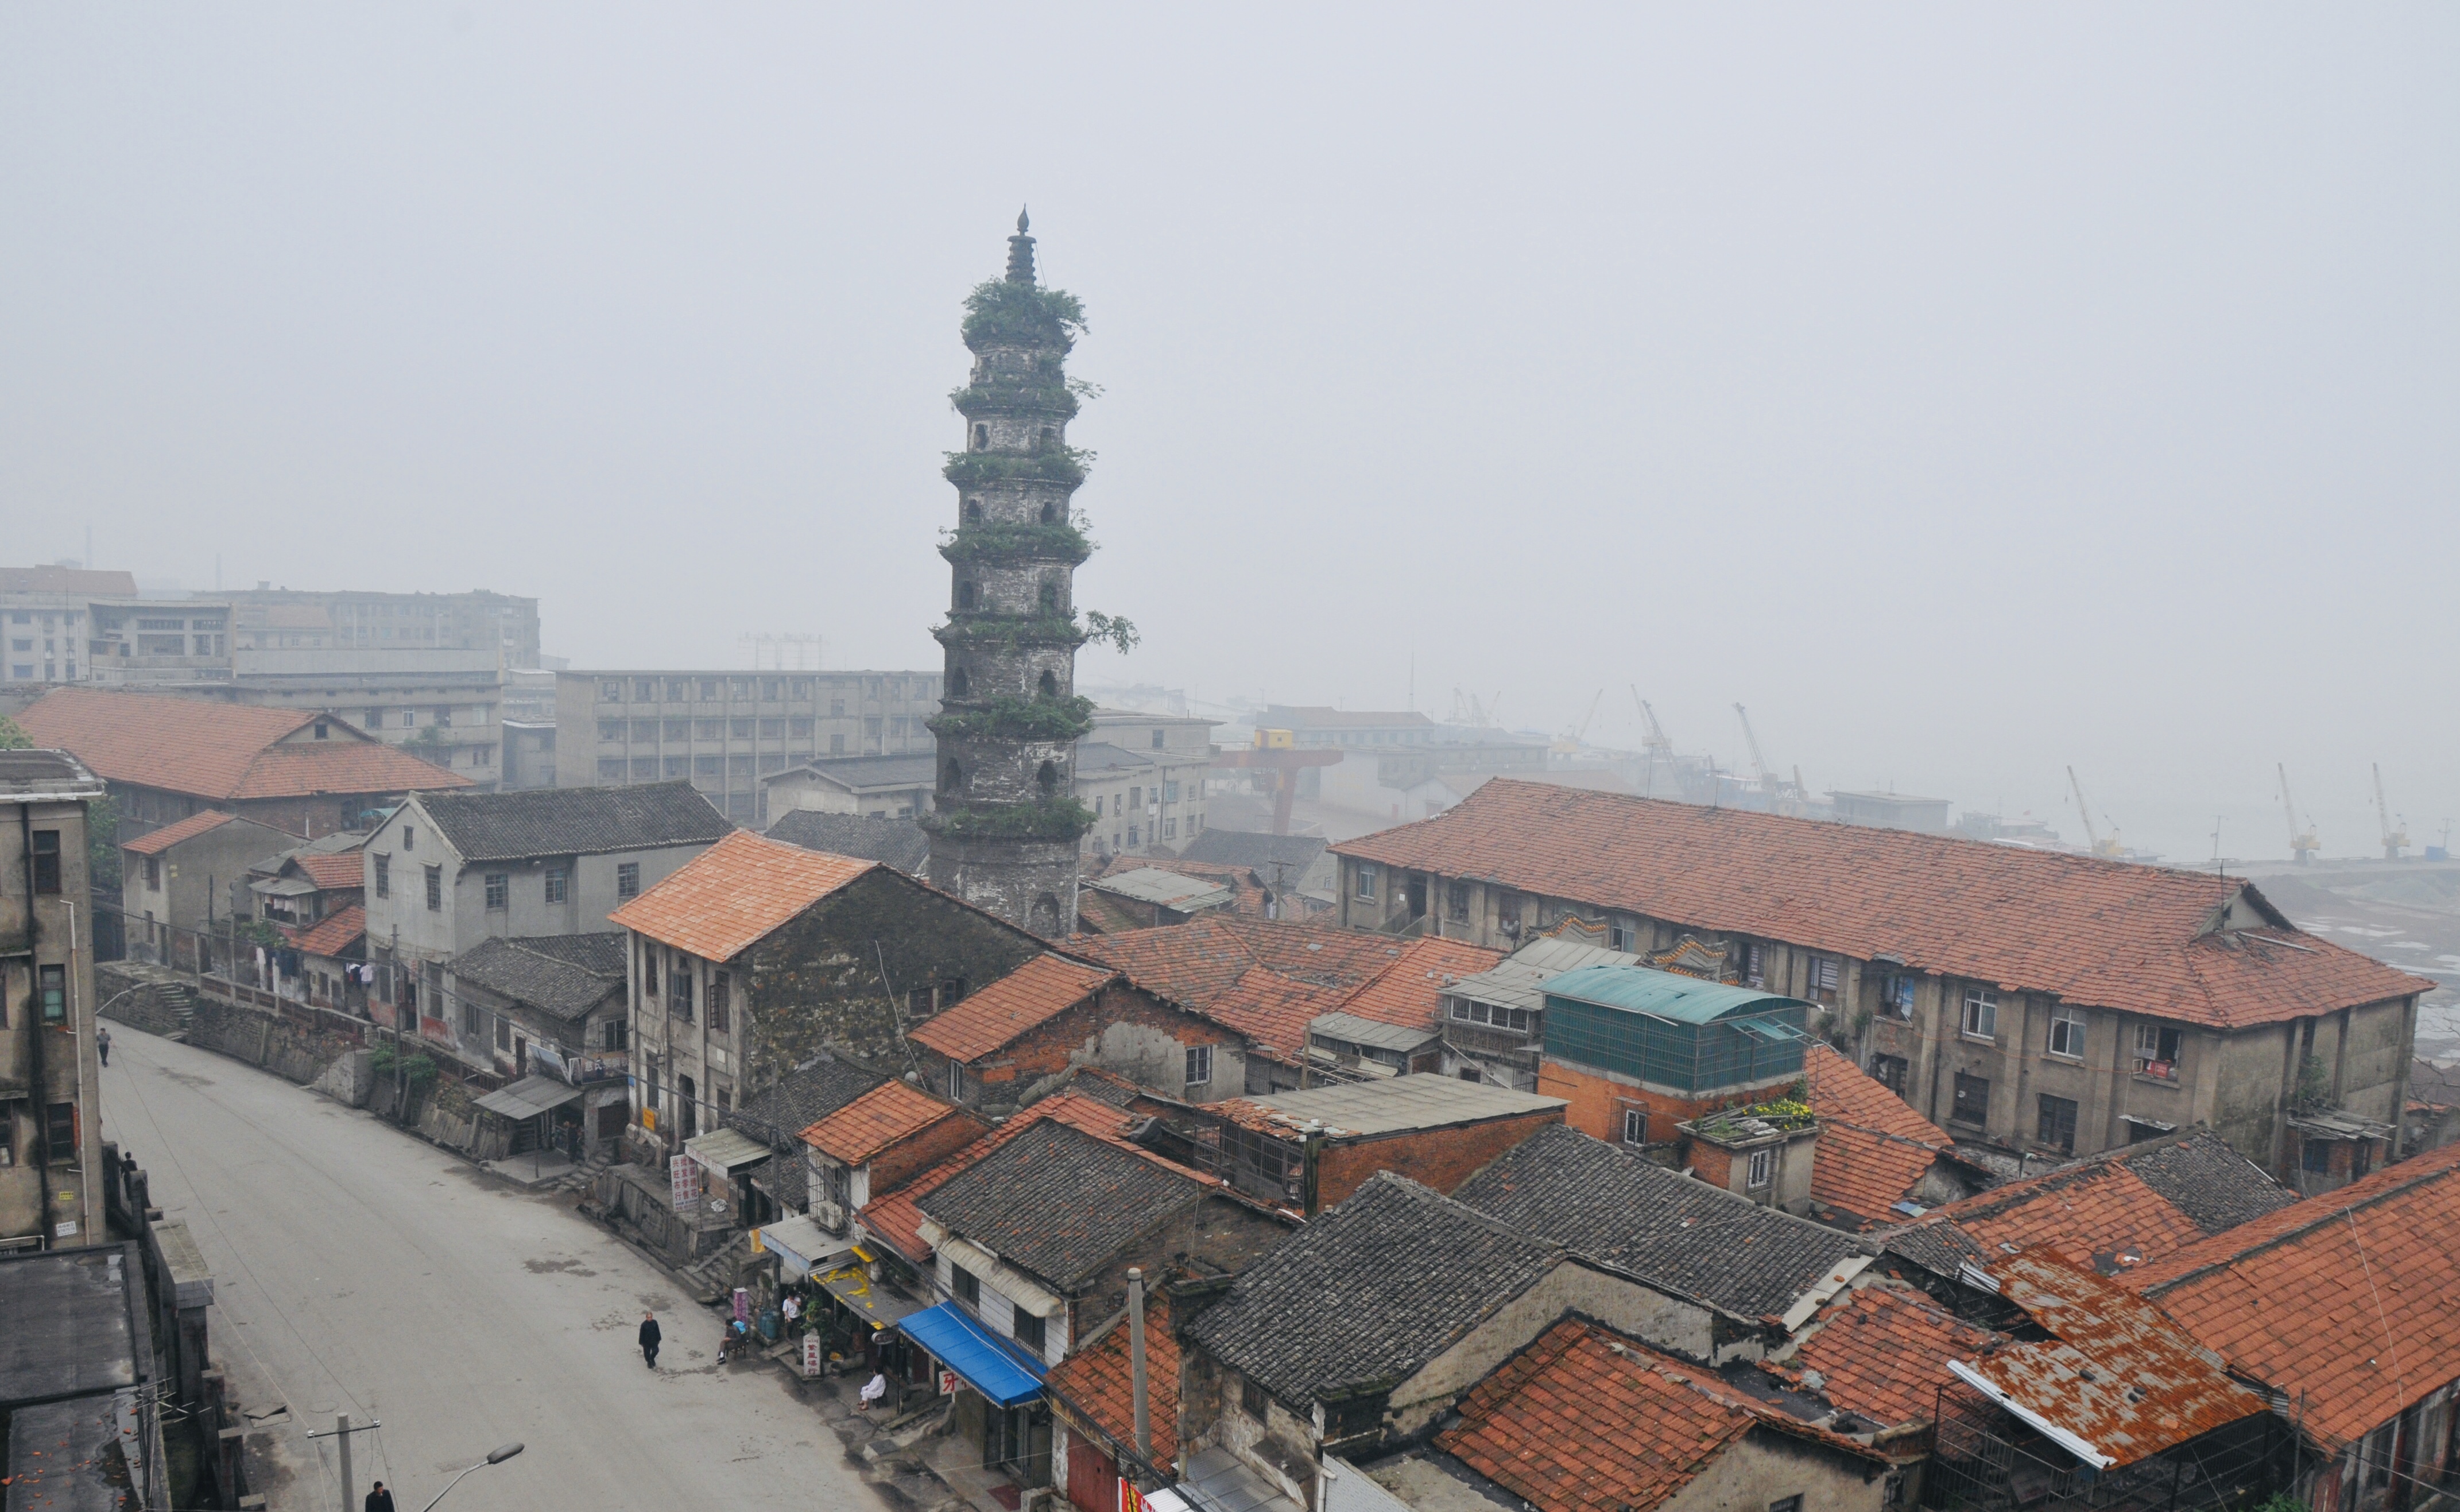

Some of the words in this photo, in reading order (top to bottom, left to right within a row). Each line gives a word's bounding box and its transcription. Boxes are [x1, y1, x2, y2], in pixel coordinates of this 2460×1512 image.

[672, 1158, 681, 1201] 兴旺布行
[680, 1157, 689, 1199] 批发零售
